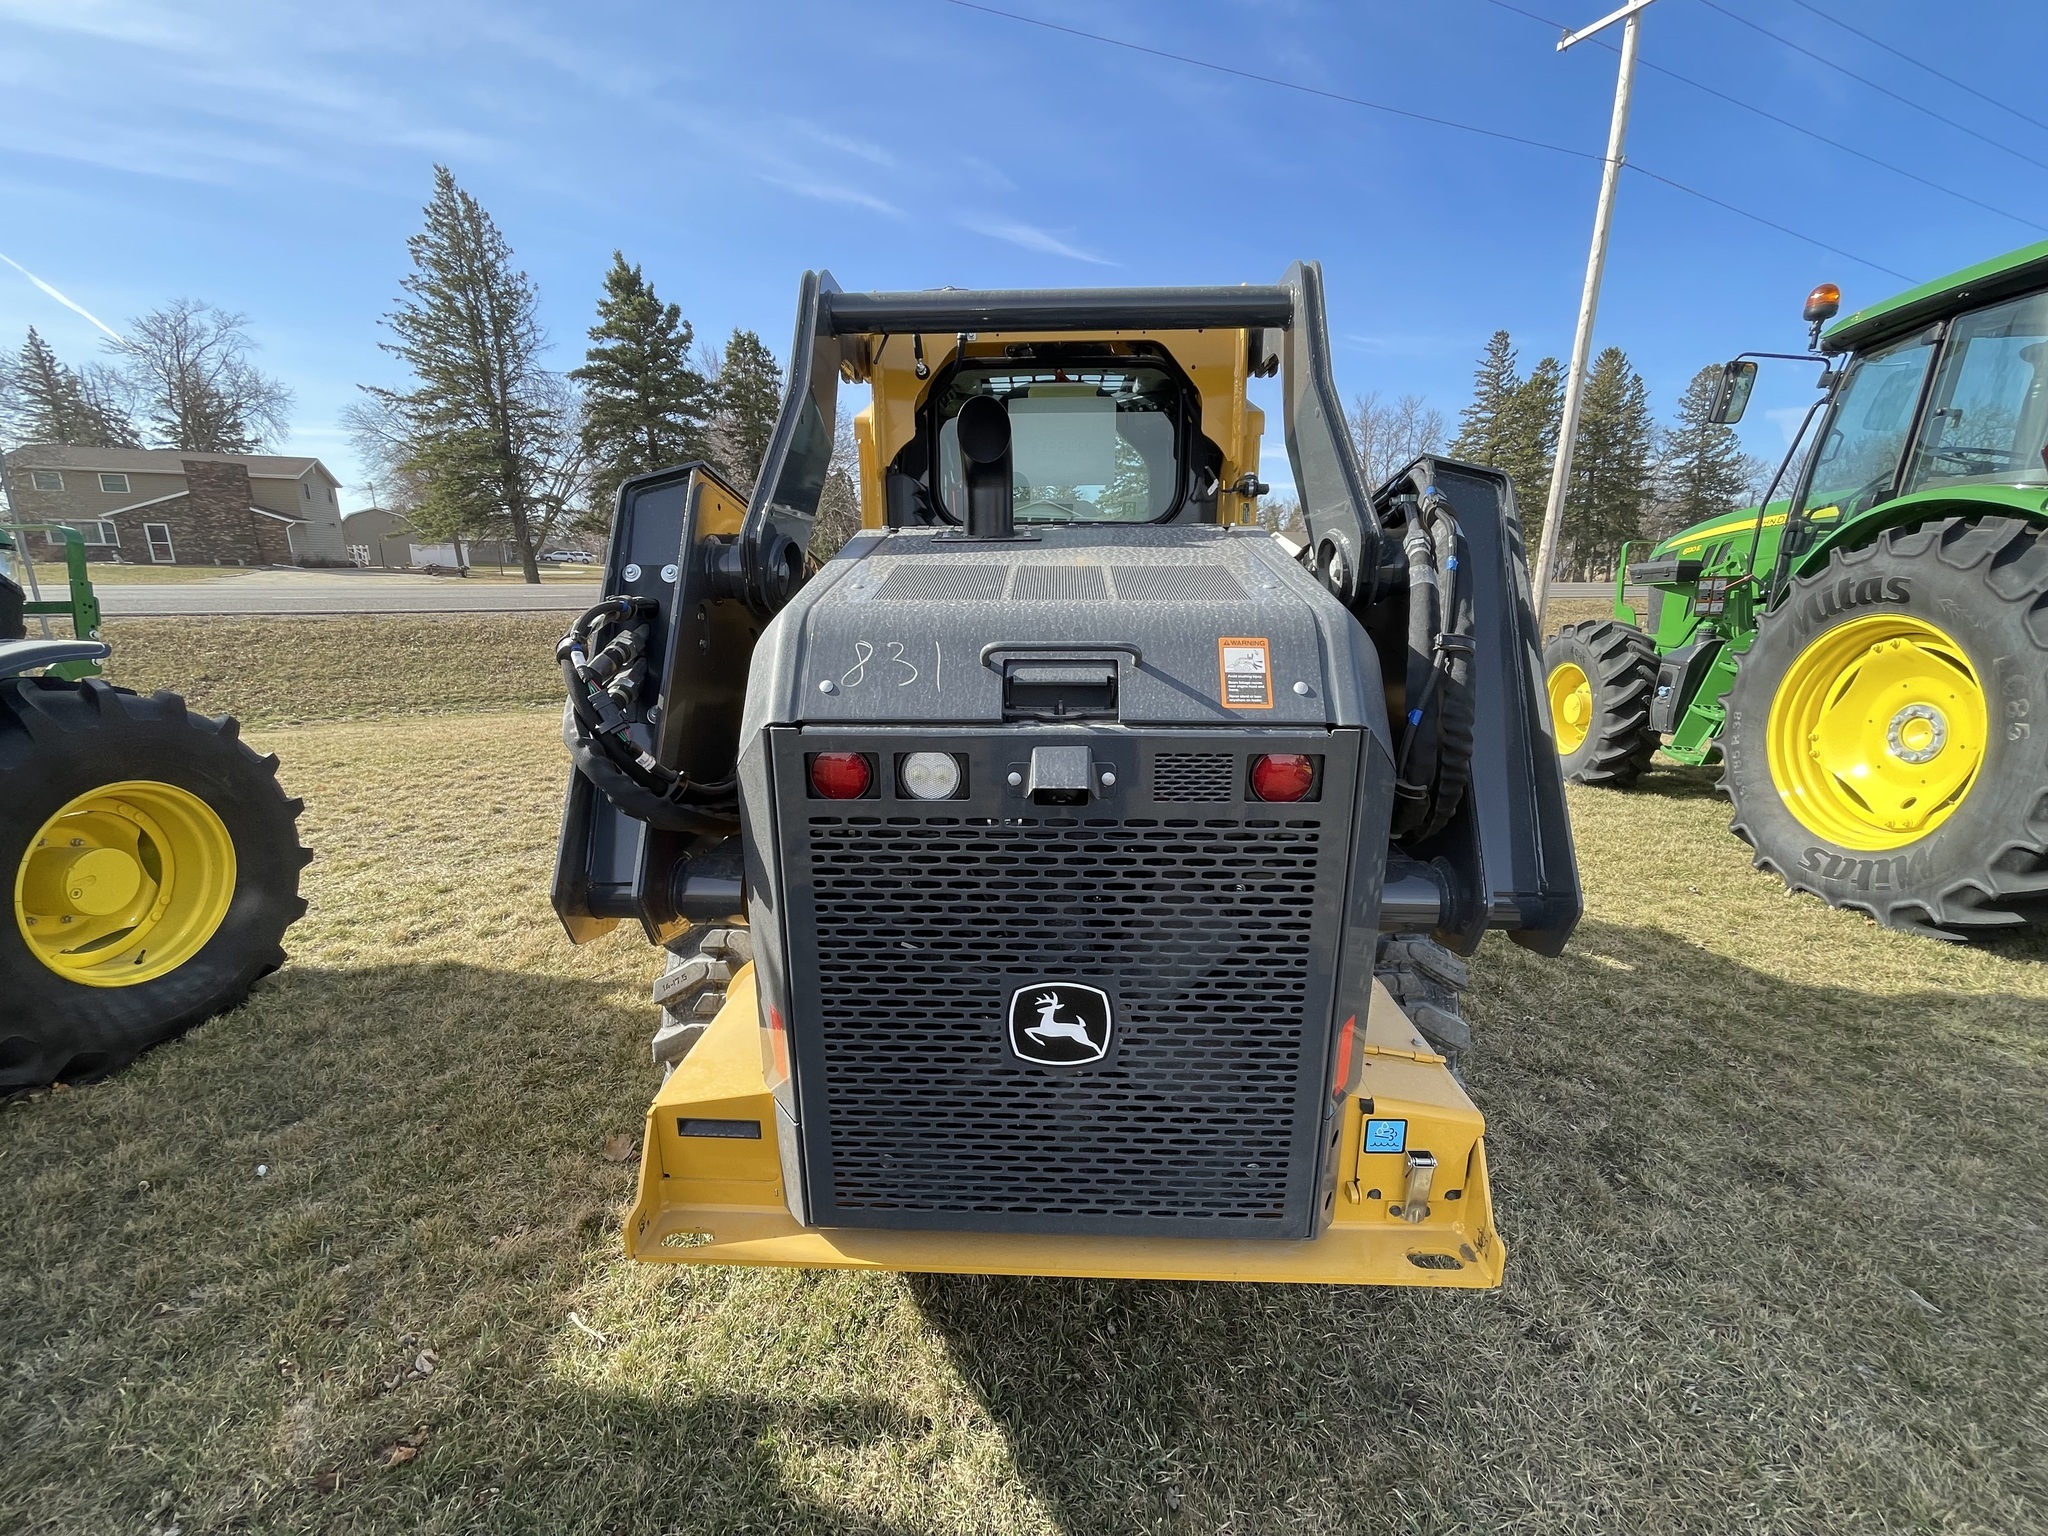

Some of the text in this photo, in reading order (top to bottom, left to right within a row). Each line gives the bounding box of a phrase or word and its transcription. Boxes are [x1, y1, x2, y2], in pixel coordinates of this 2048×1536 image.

[1787, 576, 1912, 648] Mitas
[841, 640, 941, 693] 831
[1230, 640, 1266, 648] WARNING
